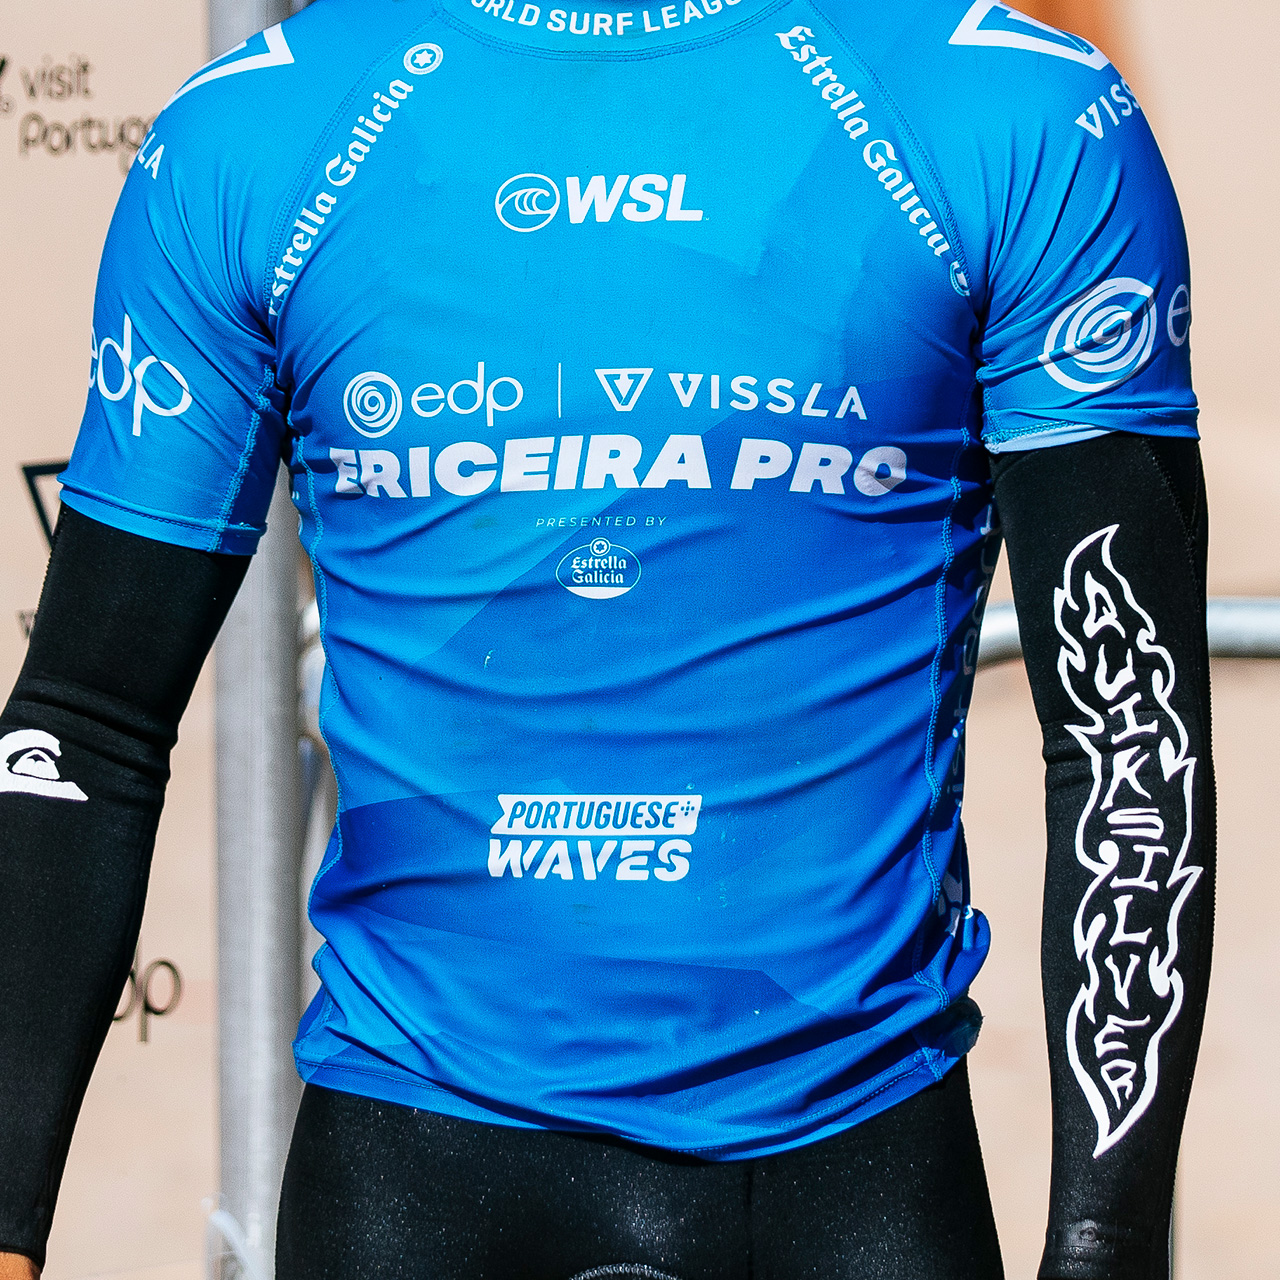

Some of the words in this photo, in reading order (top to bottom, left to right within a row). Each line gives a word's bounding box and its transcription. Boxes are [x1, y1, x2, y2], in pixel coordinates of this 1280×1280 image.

[547, 9, 633, 36] SURF
[19, 111, 157, 175] Portug
[325, 75, 414, 188] Galicia
[775, 24, 870, 141] Estrella
[861, 137, 952, 258] Galicia
[565, 173, 704, 224] WSL
[410, 362, 524, 427] edp
[667, 373, 869, 421] VISSLA
[328, 434, 713, 499] ERICEIRA
[729, 438, 909, 498] PRO
[535, 516, 637, 528] PRESENTED
[644, 515, 667, 527] BY
[571, 556, 628, 570] Estrella
[571, 569, 625, 585] Galicia
[506, 799, 680, 830] PORTUGUESE
[487, 839, 694, 882] WAVES
